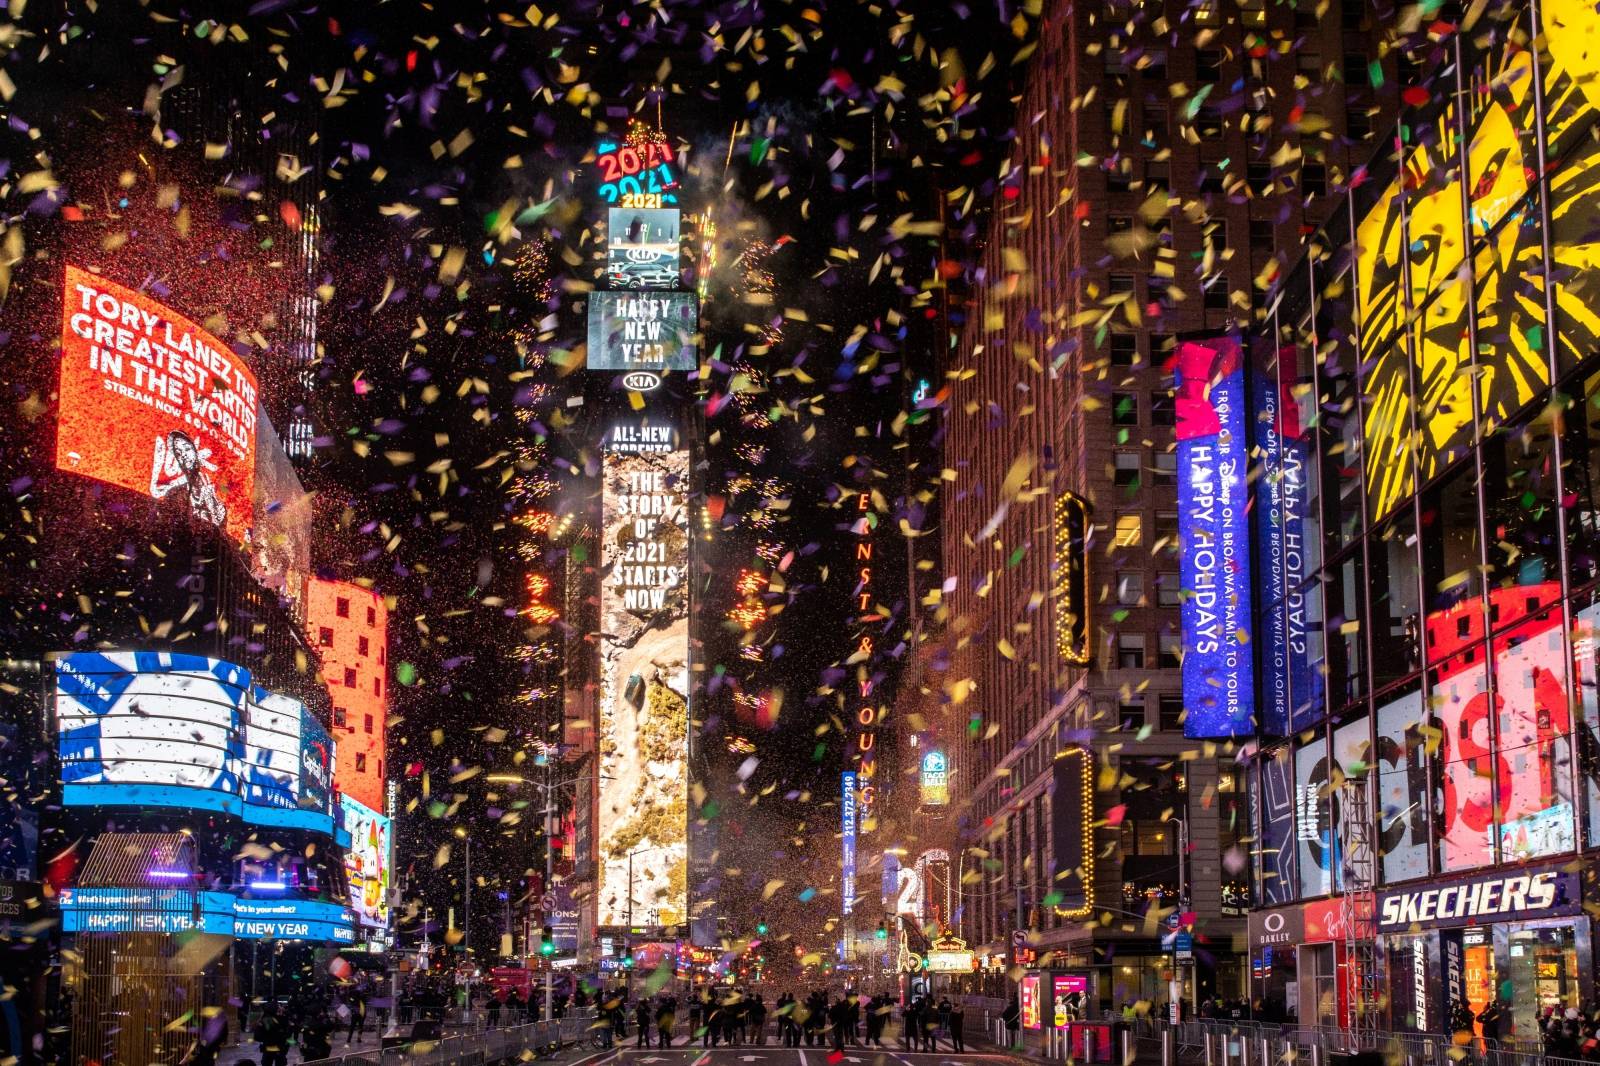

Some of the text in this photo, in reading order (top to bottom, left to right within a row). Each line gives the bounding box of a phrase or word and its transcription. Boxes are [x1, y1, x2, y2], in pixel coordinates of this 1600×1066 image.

[622, 193, 661, 208] 2021
[632, 249, 655, 259] KIA
[616, 299, 670, 317] HAPPY
[625, 322, 660, 340] NEW
[77, 284, 256, 410] TORY LANEZ THE
[622, 344, 663, 362] YEAR
[70, 312, 257, 434] GREATEST ARTIST
[90, 346, 122, 378] IN
[130, 360, 184, 404] THE
[104, 379, 182, 418] STREAM NOW
[1217, 390, 1229, 424] FROM
[613, 426, 671, 443] ALL-NEW
[630, 472, 662, 492] THE
[618, 495, 674, 515] STORY
[1222, 508, 1233, 528] ON
[635, 519, 656, 539] OF
[625, 542, 665, 562] 2021
[1190, 446, 1219, 654] HAPPY HOLIDAYS
[1223, 532, 1234, 599] BROADWAY
[613, 566, 678, 586] STARTS
[625, 590, 665, 609] NOW
[1225, 605, 1236, 647] FAMILY
[1226, 651, 1237, 667] TO
[1379, 871, 1558, 926] SKECHERS
[88, 915, 129, 927] HAPPY
[246, 923, 275, 935] NEW
[277, 923, 309, 936] YEAR
[1260, 932, 1290, 944] OAKLEY
[1413, 939, 1428, 1032] SKECHERS
